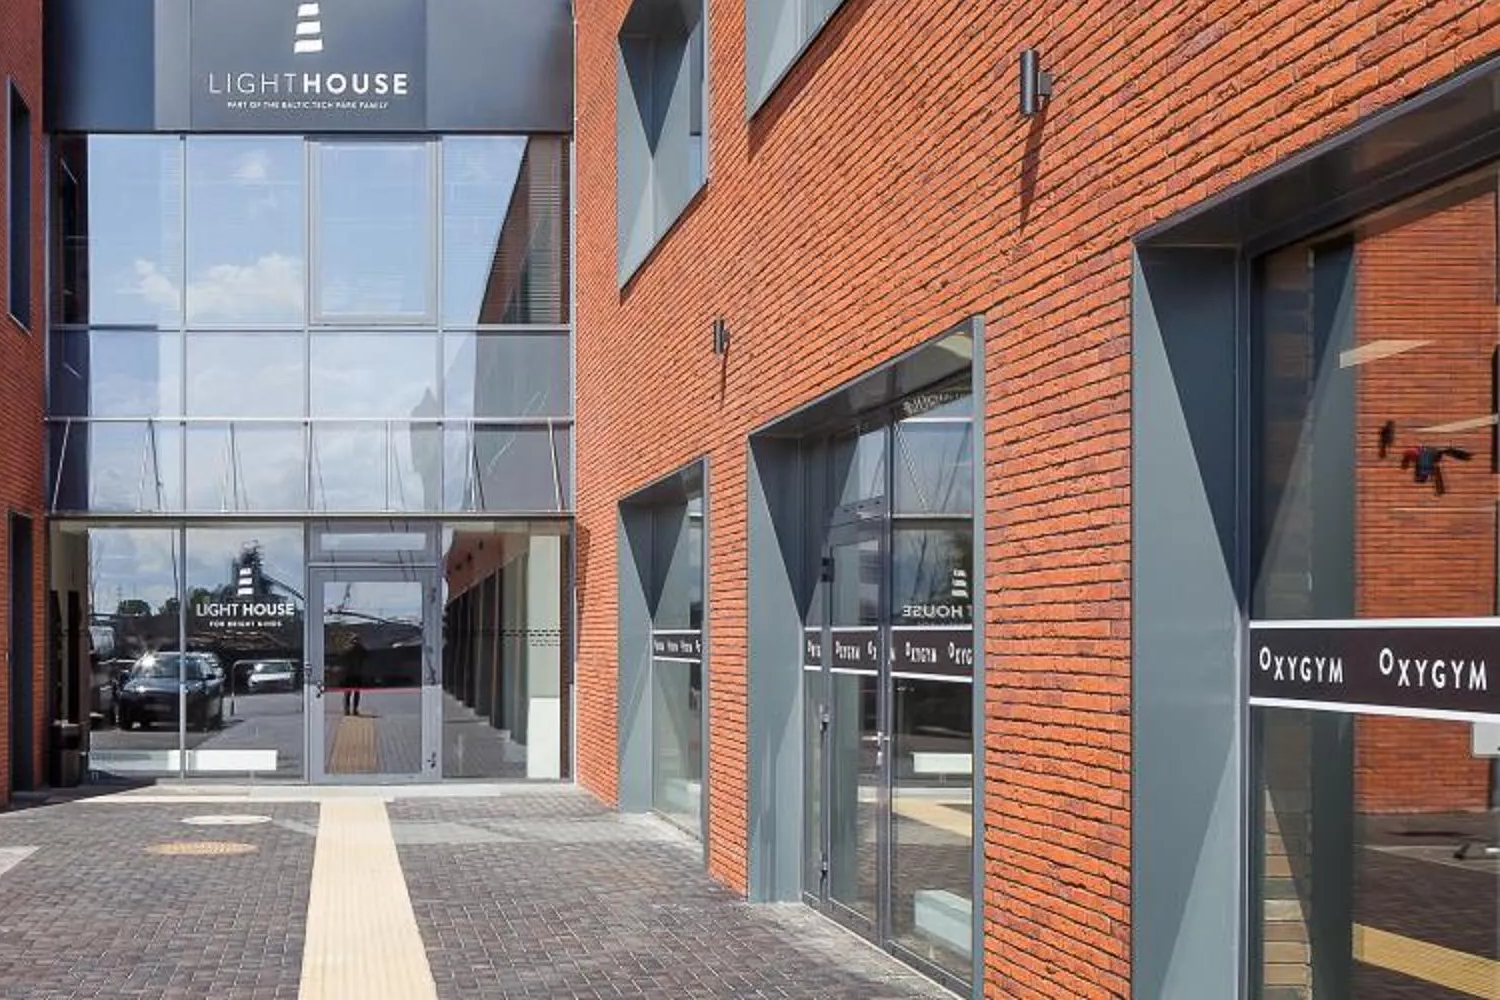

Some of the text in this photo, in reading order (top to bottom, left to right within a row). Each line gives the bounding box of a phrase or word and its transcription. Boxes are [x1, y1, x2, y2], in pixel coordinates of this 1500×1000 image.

[209, 73, 408, 94] LIGHTHOUSE
[196, 603, 295, 617] LIGHT HOUSE
[948, 641, 973, 666] OXYG
[1259, 646, 1488, 691] OXYGYM OXYGYM
